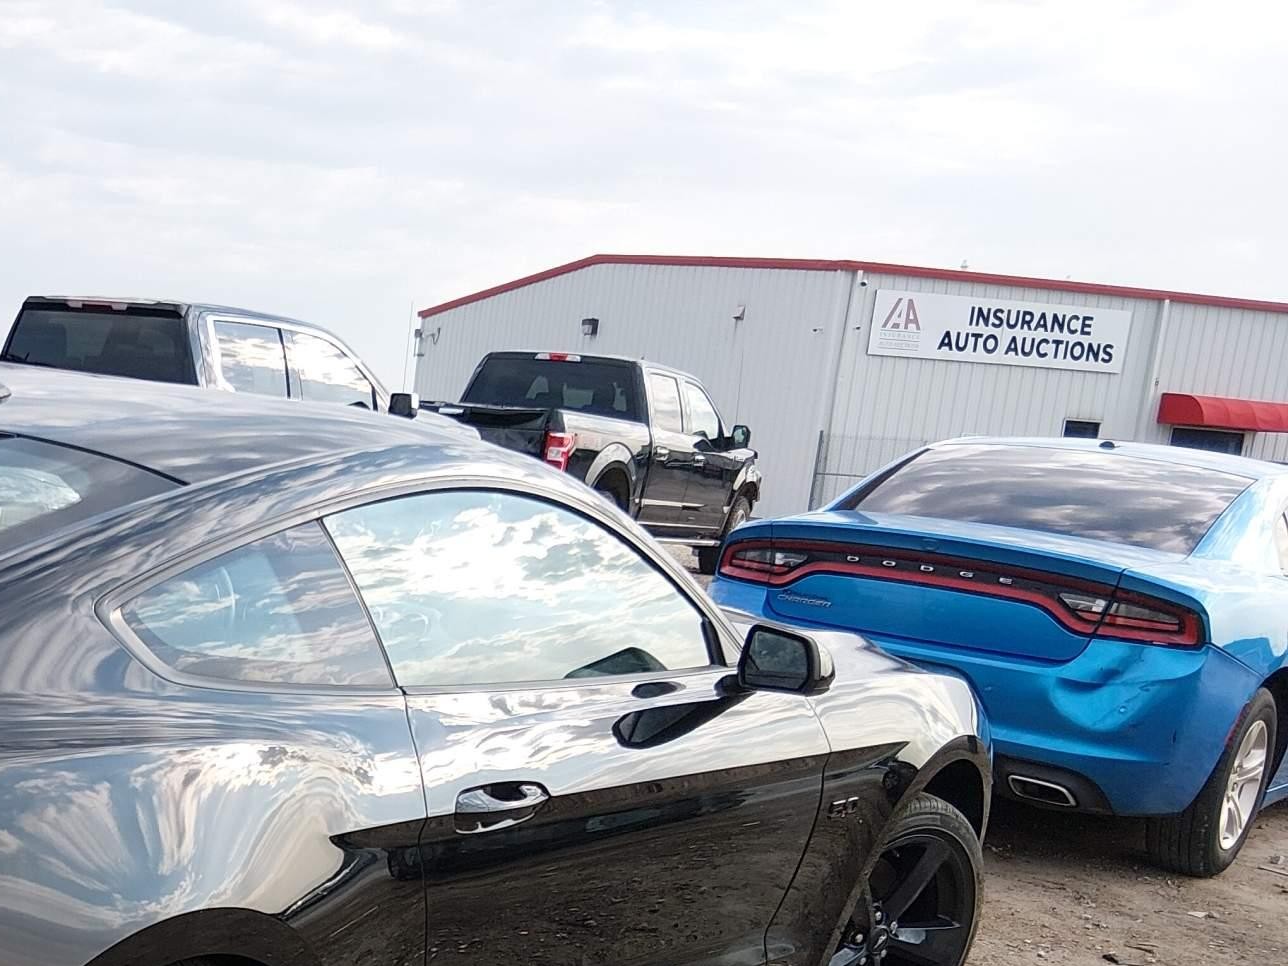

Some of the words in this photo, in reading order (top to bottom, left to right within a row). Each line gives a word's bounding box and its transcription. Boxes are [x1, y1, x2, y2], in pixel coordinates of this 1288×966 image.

[968, 305, 1094, 336] INSURANCE
[937, 330, 999, 355] AUTO
[1004, 335, 1114, 364] AUCTIONS
[846, 555, 1013, 585] DODGE
